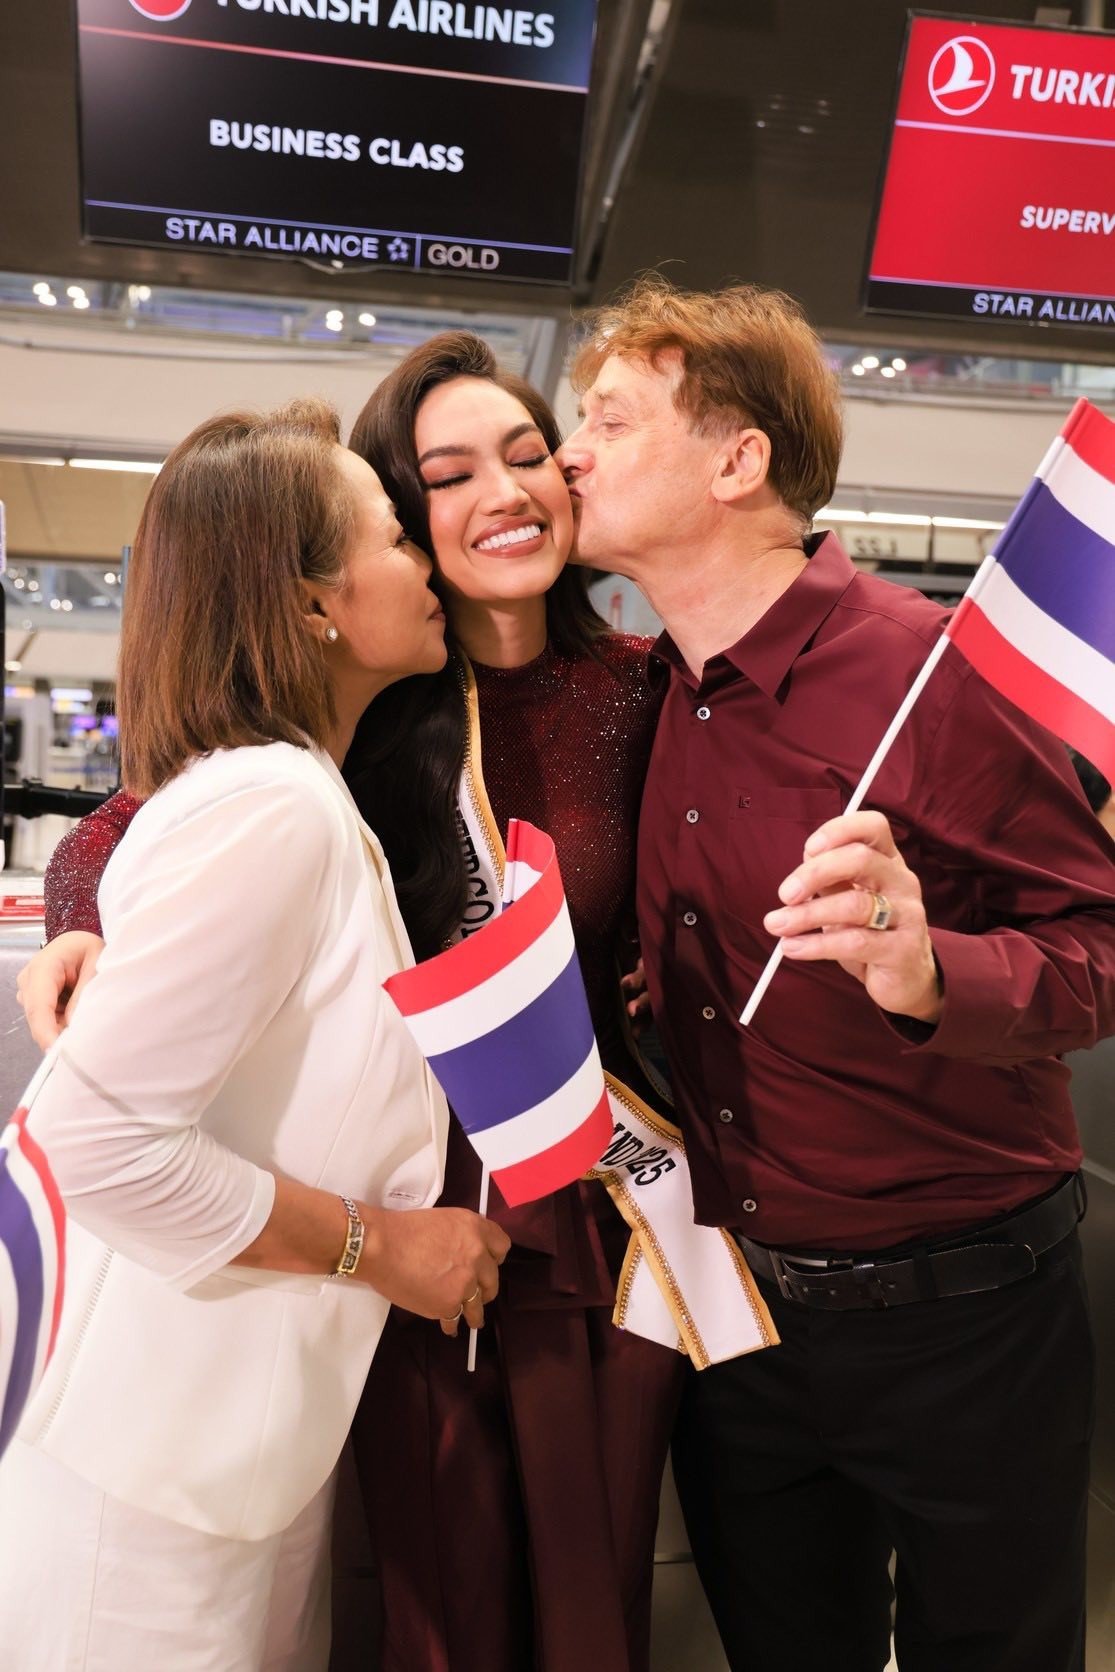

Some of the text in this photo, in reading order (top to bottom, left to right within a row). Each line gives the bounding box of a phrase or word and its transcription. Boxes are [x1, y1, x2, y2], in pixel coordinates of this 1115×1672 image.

[388, 0, 555, 48] AIRLINES
[1010, 64, 1115, 108] TURKI
[209, 118, 465, 173] BUSINESS CLASS
[1020, 205, 1115, 235] SUPERV
[165, 216, 500, 271] STAR ALLIANCE GOLD
[972, 292, 1033, 317] STAR
